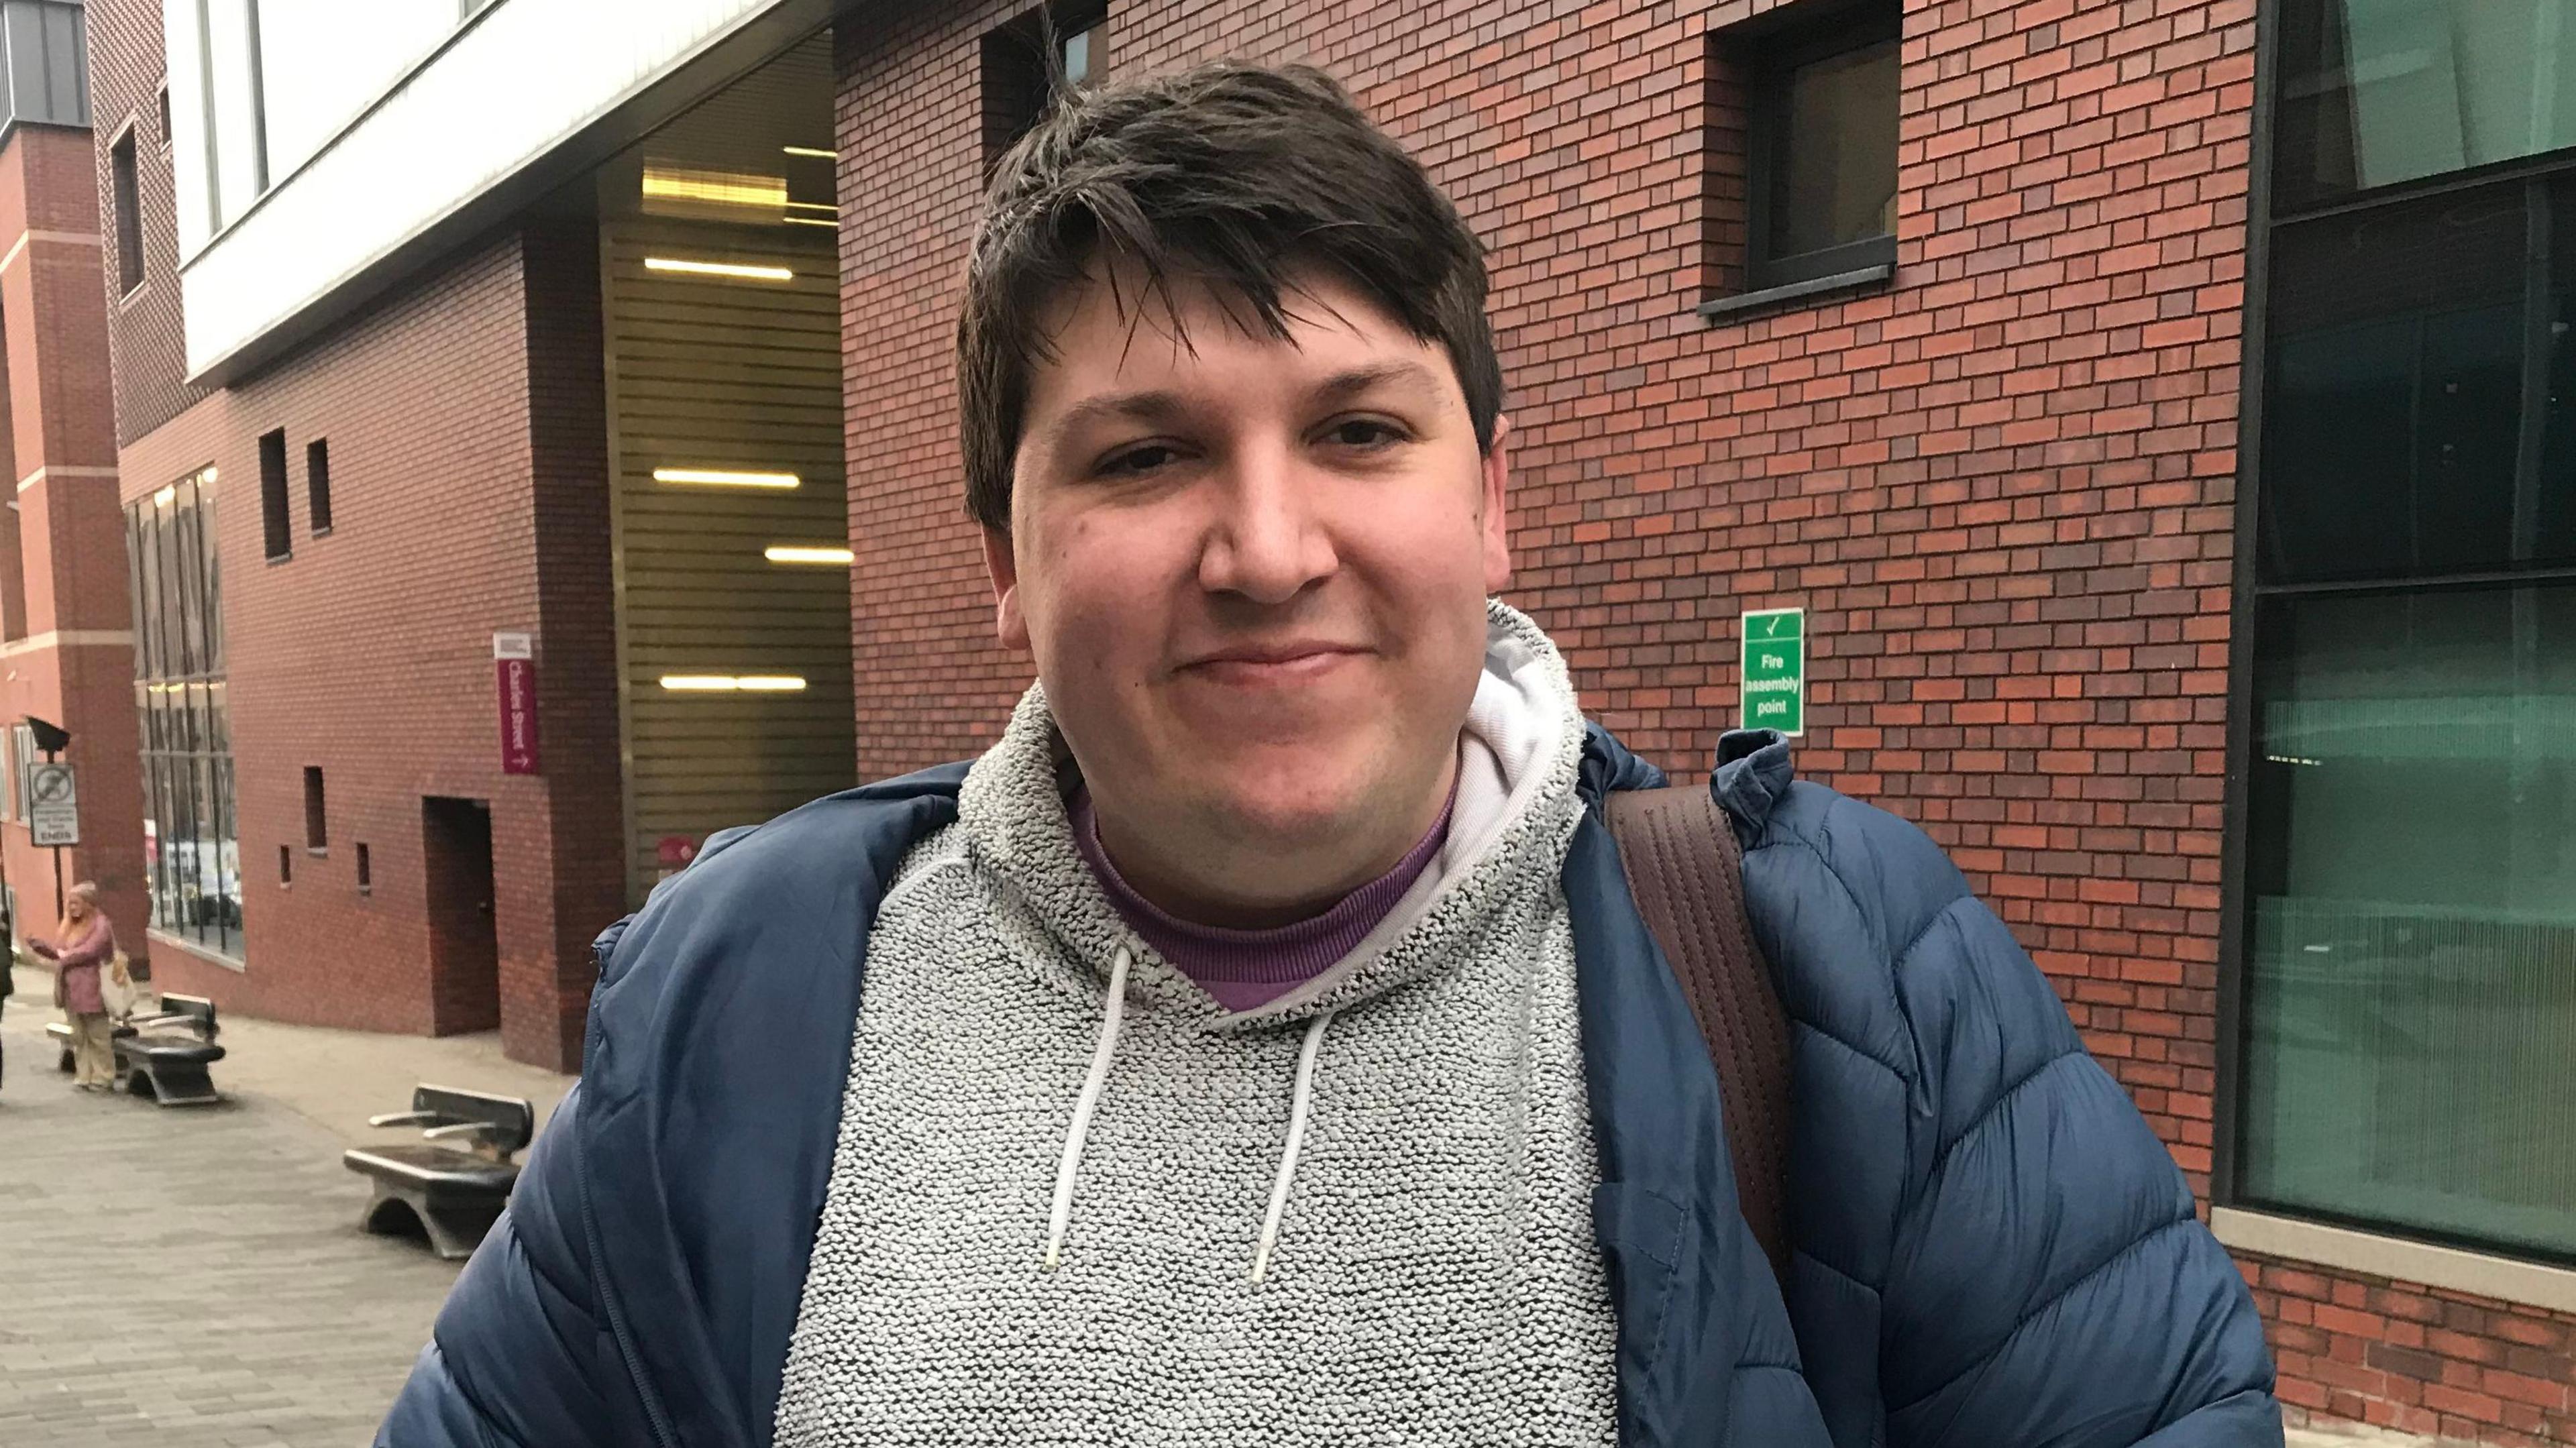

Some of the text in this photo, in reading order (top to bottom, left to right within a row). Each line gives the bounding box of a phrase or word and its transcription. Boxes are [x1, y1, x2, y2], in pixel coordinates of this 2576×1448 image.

[1762, 655, 1784, 669] Fire
[1746, 677, 1799, 693] assembly
[1758, 700, 1786, 717] point
